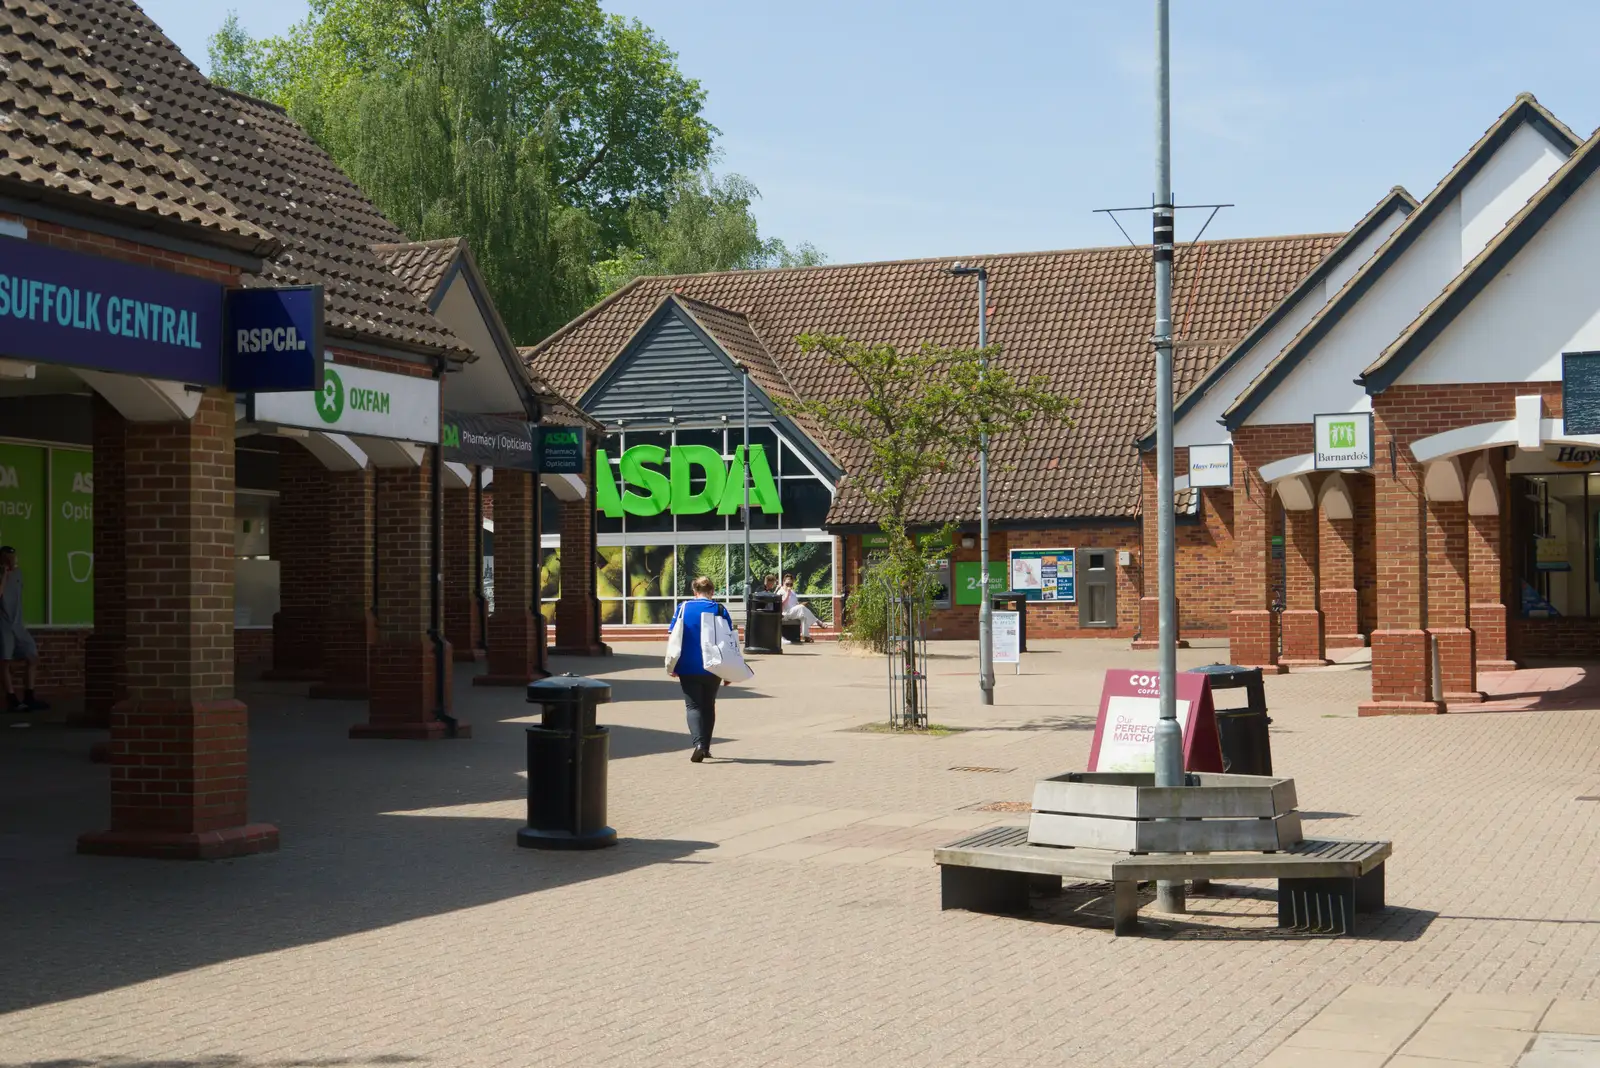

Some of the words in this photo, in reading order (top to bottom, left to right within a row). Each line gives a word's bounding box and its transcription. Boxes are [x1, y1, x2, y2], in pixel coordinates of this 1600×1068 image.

[0, 274, 101, 332] SUFFOLK
[106, 296, 202, 349] CENTRAL
[350, 387, 390, 414] OXFAM
[462, 430, 496, 449] Pharmacy
[501, 436, 532, 452] Opticians
[545, 432, 579, 445] ASDA
[545, 448, 577, 456] Pharmacy
[1318, 452, 1368, 462] Barnardo's
[1129, 674, 1160, 688] COS
[1116, 715, 1133, 723] Our
[1114, 724, 1156, 733] PERFEC
